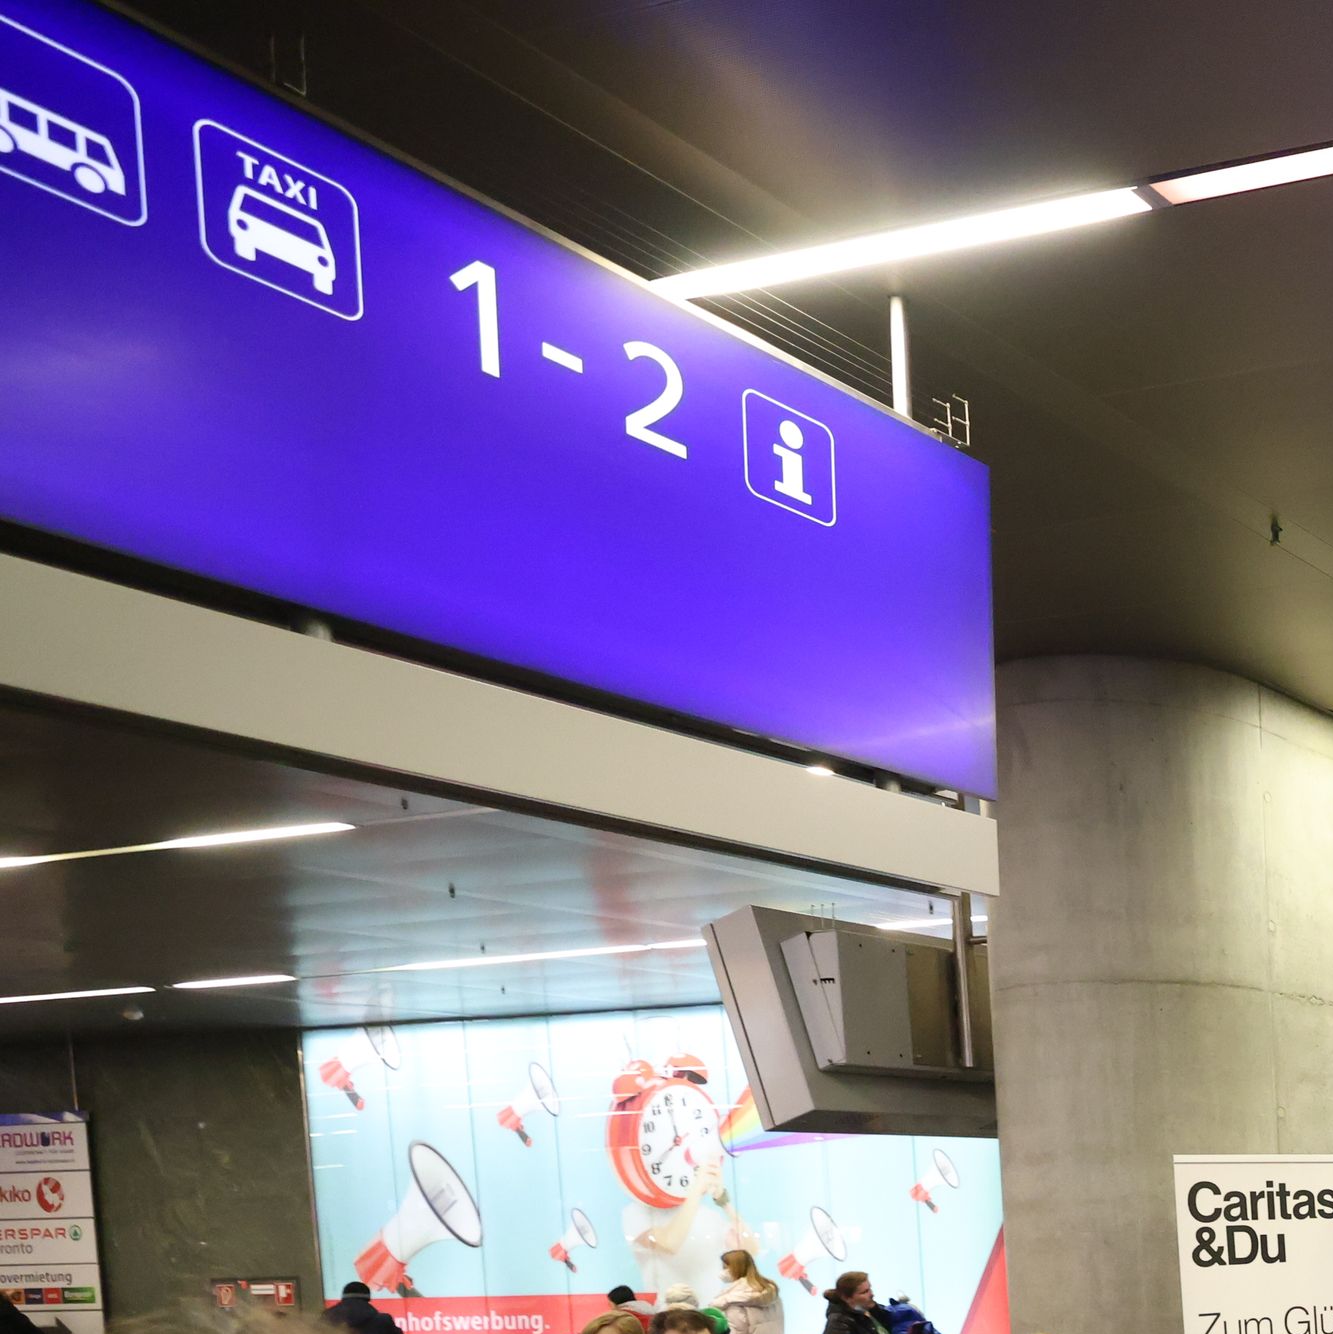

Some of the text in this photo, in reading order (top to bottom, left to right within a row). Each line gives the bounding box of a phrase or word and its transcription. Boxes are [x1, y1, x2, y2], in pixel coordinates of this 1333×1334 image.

[237, 151, 318, 211] TAXI
[1191, 1225, 1287, 1268] &Du
[0, 1271, 73, 1286] overmietung
